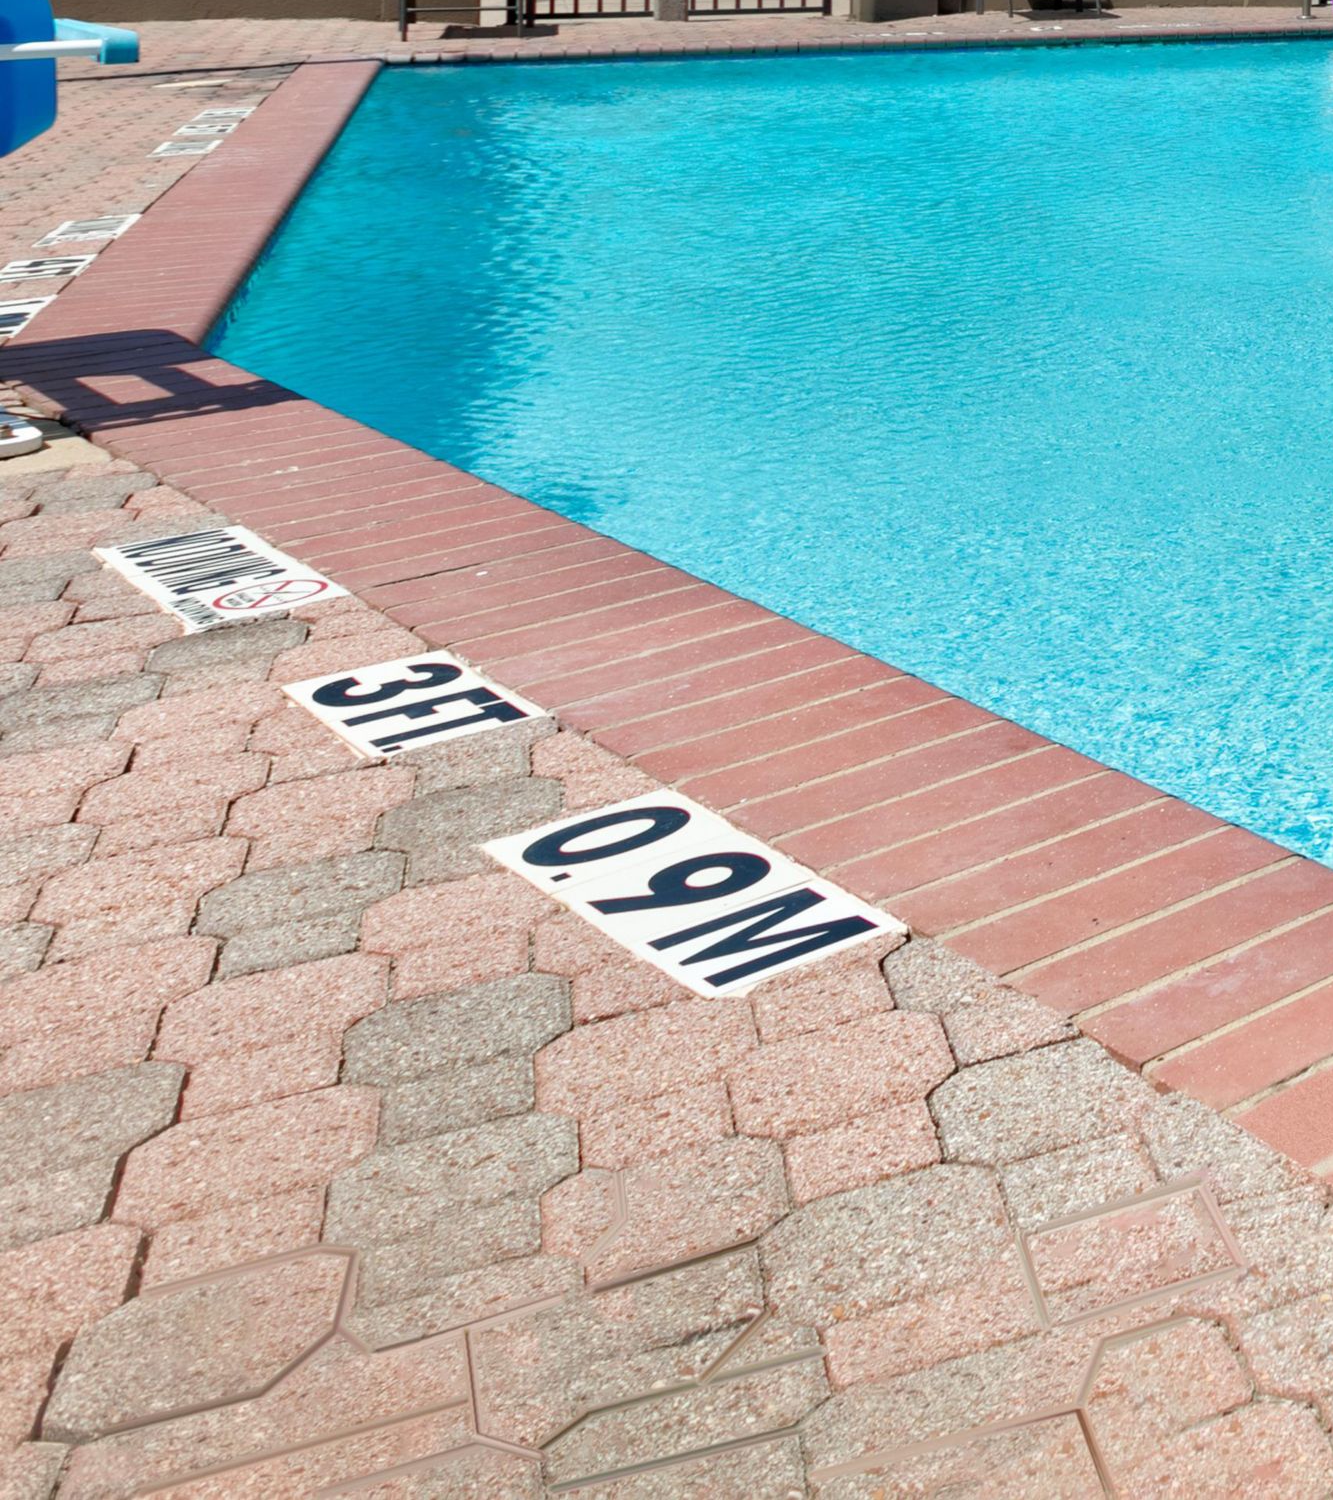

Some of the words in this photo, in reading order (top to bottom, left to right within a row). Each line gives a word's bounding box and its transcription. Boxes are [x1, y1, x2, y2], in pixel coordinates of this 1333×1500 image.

[115, 529, 237, 559] NO
[133, 544, 287, 595] DIVING
[522, 806, 879, 987] 0.9M
